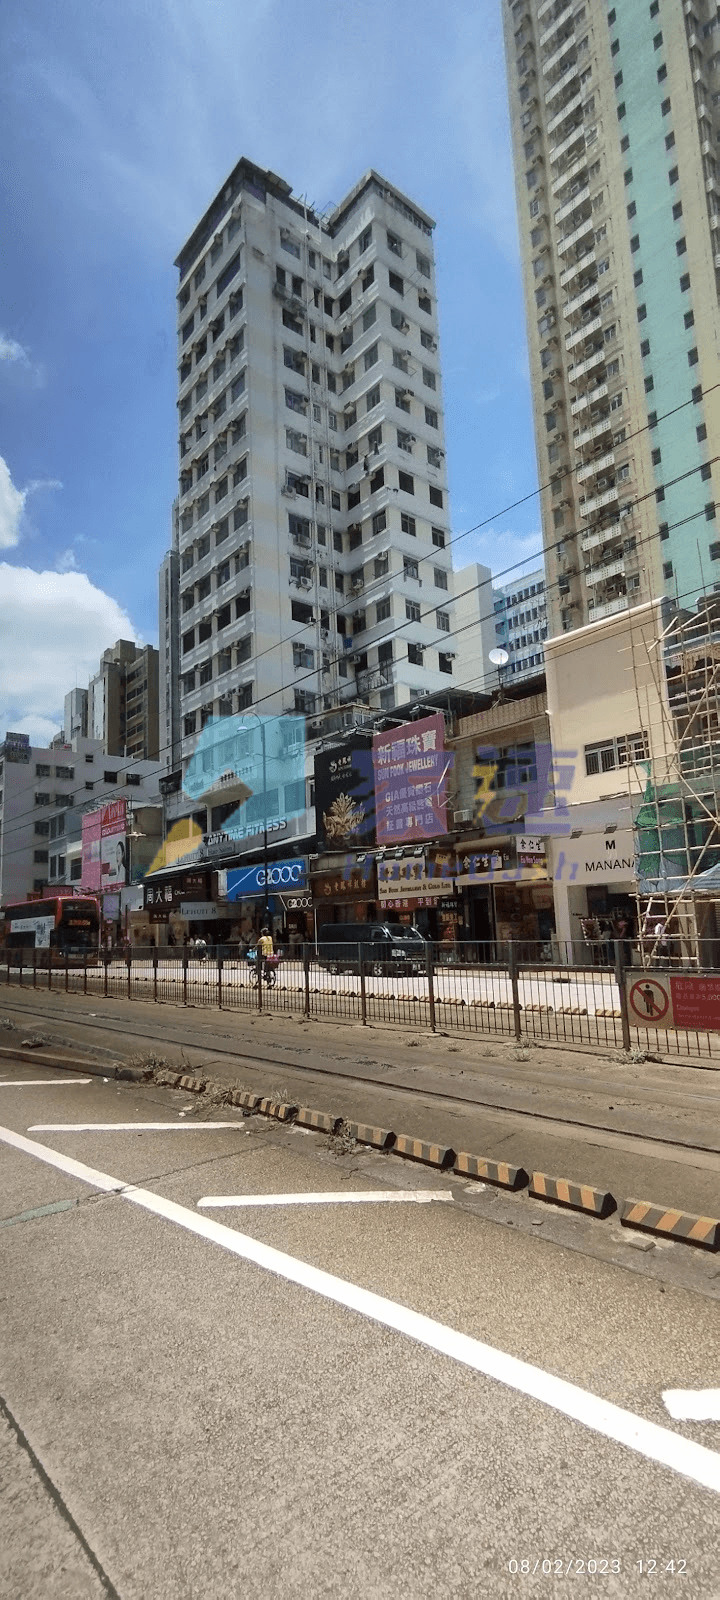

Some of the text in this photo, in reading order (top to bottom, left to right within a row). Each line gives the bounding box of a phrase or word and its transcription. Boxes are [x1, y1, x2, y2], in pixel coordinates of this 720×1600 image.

[406, 752, 439, 774] JEWELLERY
[207, 816, 287, 846] ANYTIME FITNESS
[605, 840, 616, 850] M
[585, 858, 634, 872] MANAN
[146, 885, 173, 904] 周大福
[287, 897, 313, 909] G2000
